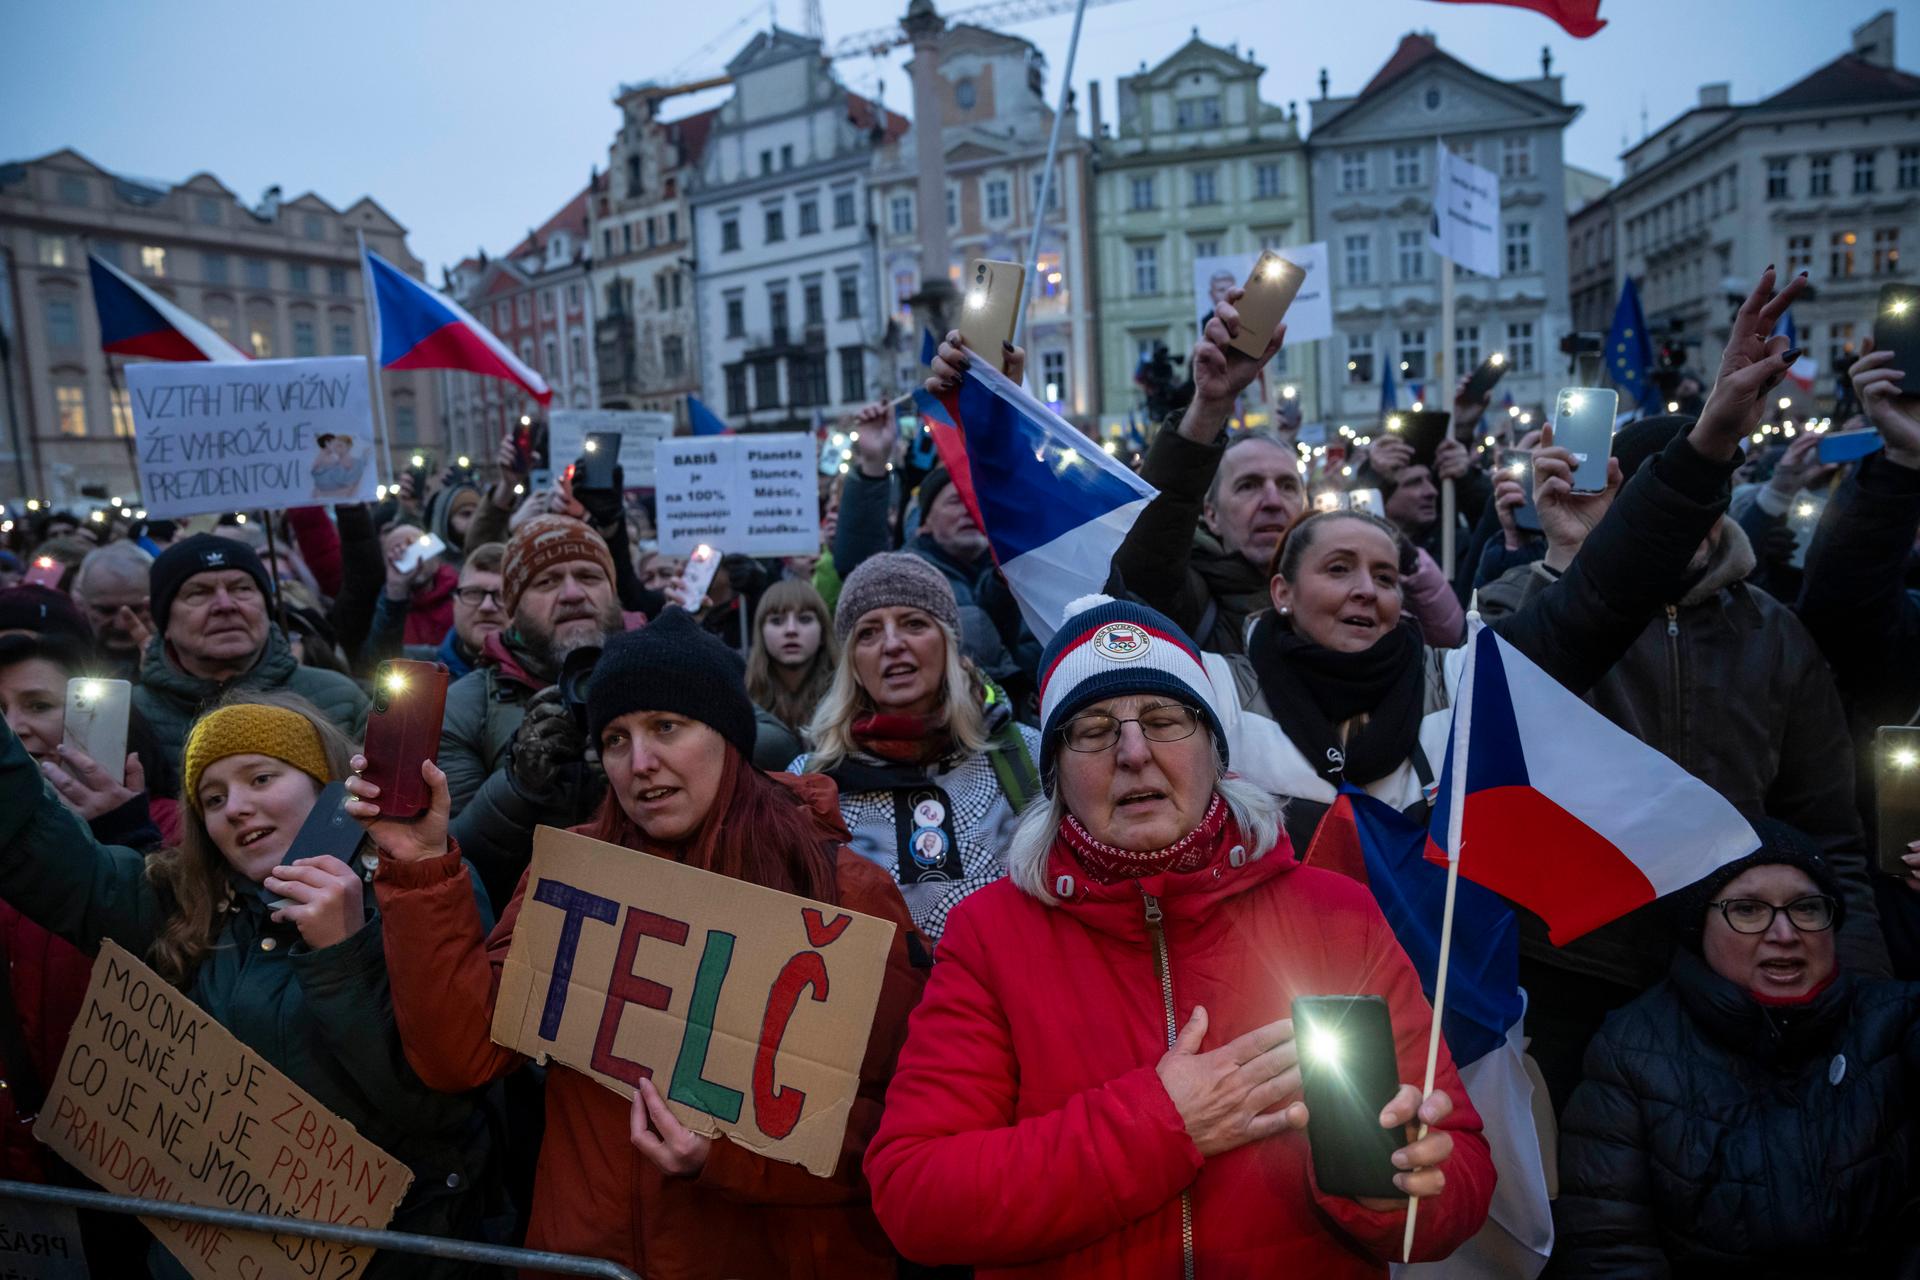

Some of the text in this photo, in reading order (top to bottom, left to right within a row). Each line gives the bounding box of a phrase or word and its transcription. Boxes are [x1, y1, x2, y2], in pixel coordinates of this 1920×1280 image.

[137, 373, 351, 420] VZTAH TAK VÁŽNÝ
[144, 421, 312, 464] ŽE VYHROŽUJE
[674, 452, 718, 467] BABIŠ
[748, 449, 802, 460] Planeta
[147, 460, 300, 503] PREZIDENTOVI
[690, 473, 702, 484] je
[750, 468, 803, 480] Slunce,
[665, 490, 725, 502] na 100%
[672, 525, 726, 539] premiér
[533, 877, 853, 1140] TELČ
[68, 1044, 107, 1097] CO
[107, 1077, 147, 1133] JE
[85, 999, 232, 1124] MOCNĚJŠÍ
[219, 1111, 260, 1160] JE
[102, 958, 387, 1206] MOCNÁ JE ZBRAŇ
